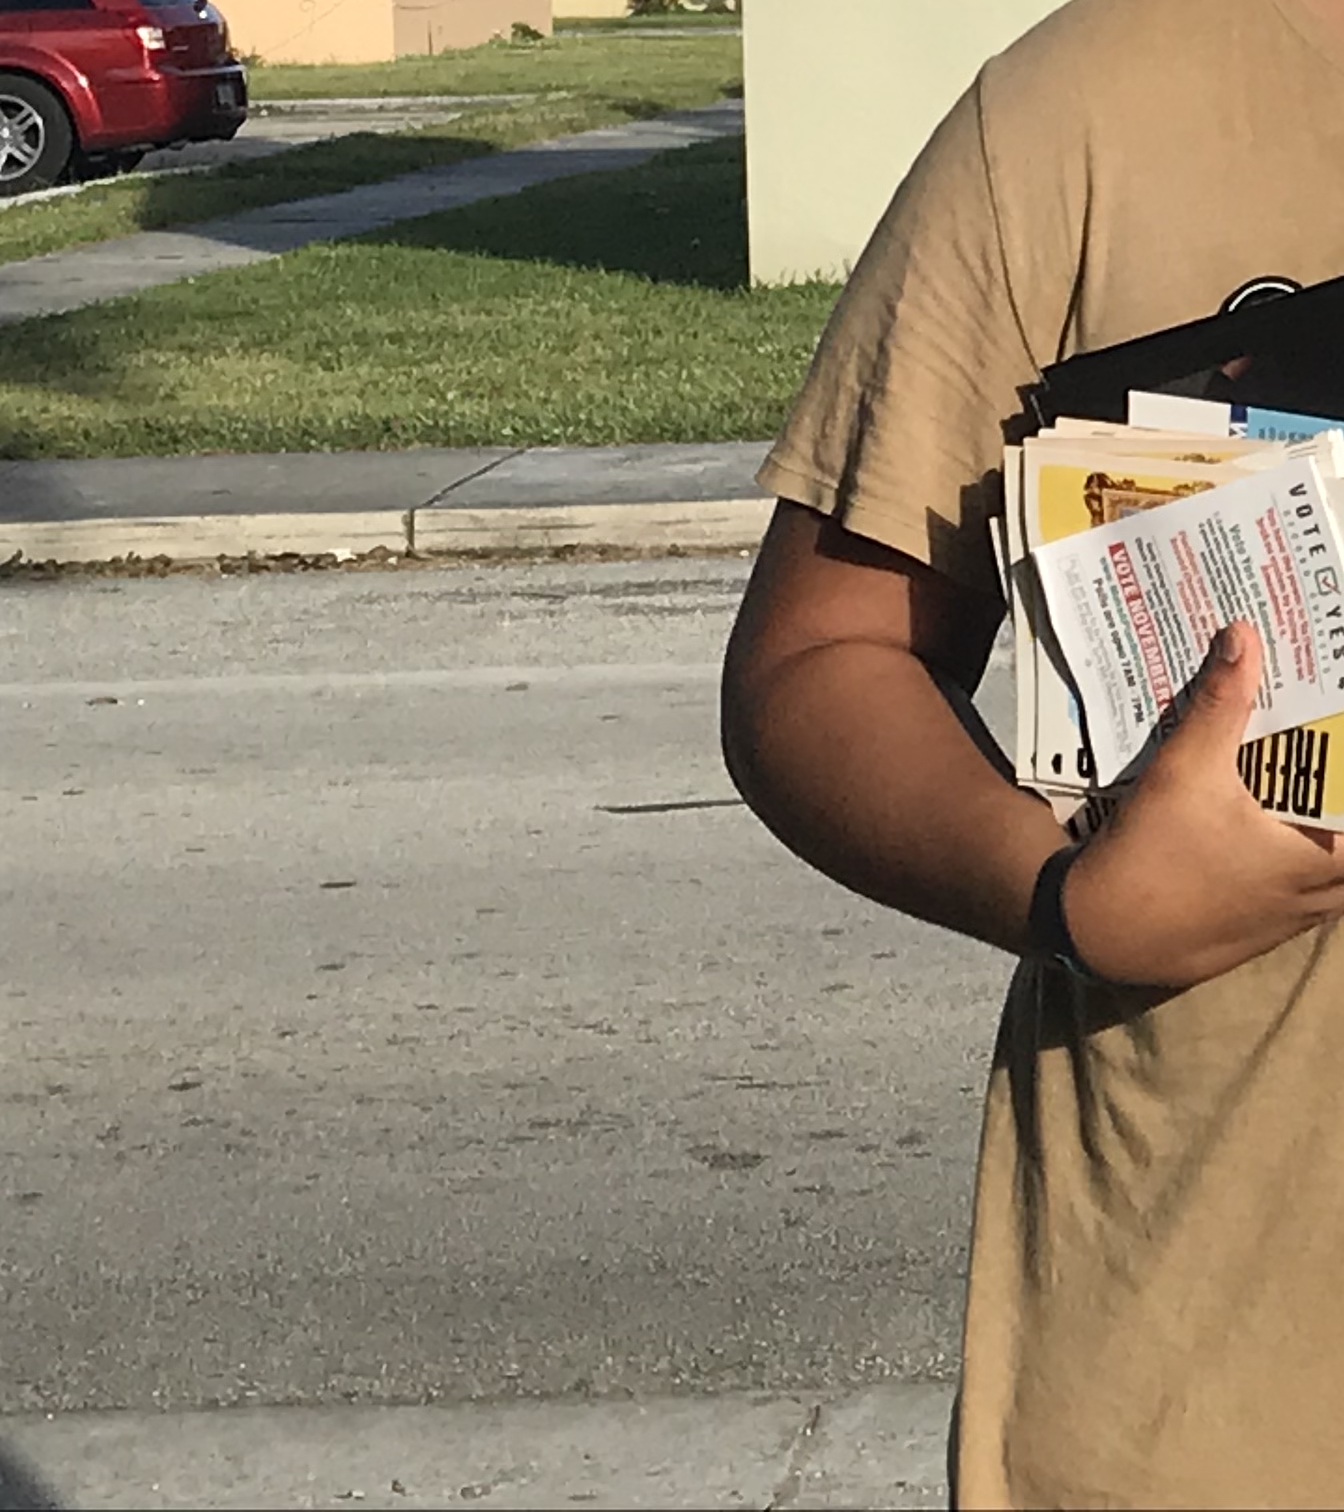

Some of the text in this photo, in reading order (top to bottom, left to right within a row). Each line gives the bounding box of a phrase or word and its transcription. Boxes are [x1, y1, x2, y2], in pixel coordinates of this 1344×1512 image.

[1287, 482, 1327, 558] VOTE
[1228, 524, 1247, 555] Vote
[1240, 556, 1255, 581] Yes
[1249, 582, 1262, 599] on
[1111, 549, 1172, 704] VOTE NOVEMBER
[1121, 660, 1136, 688] 7AM
